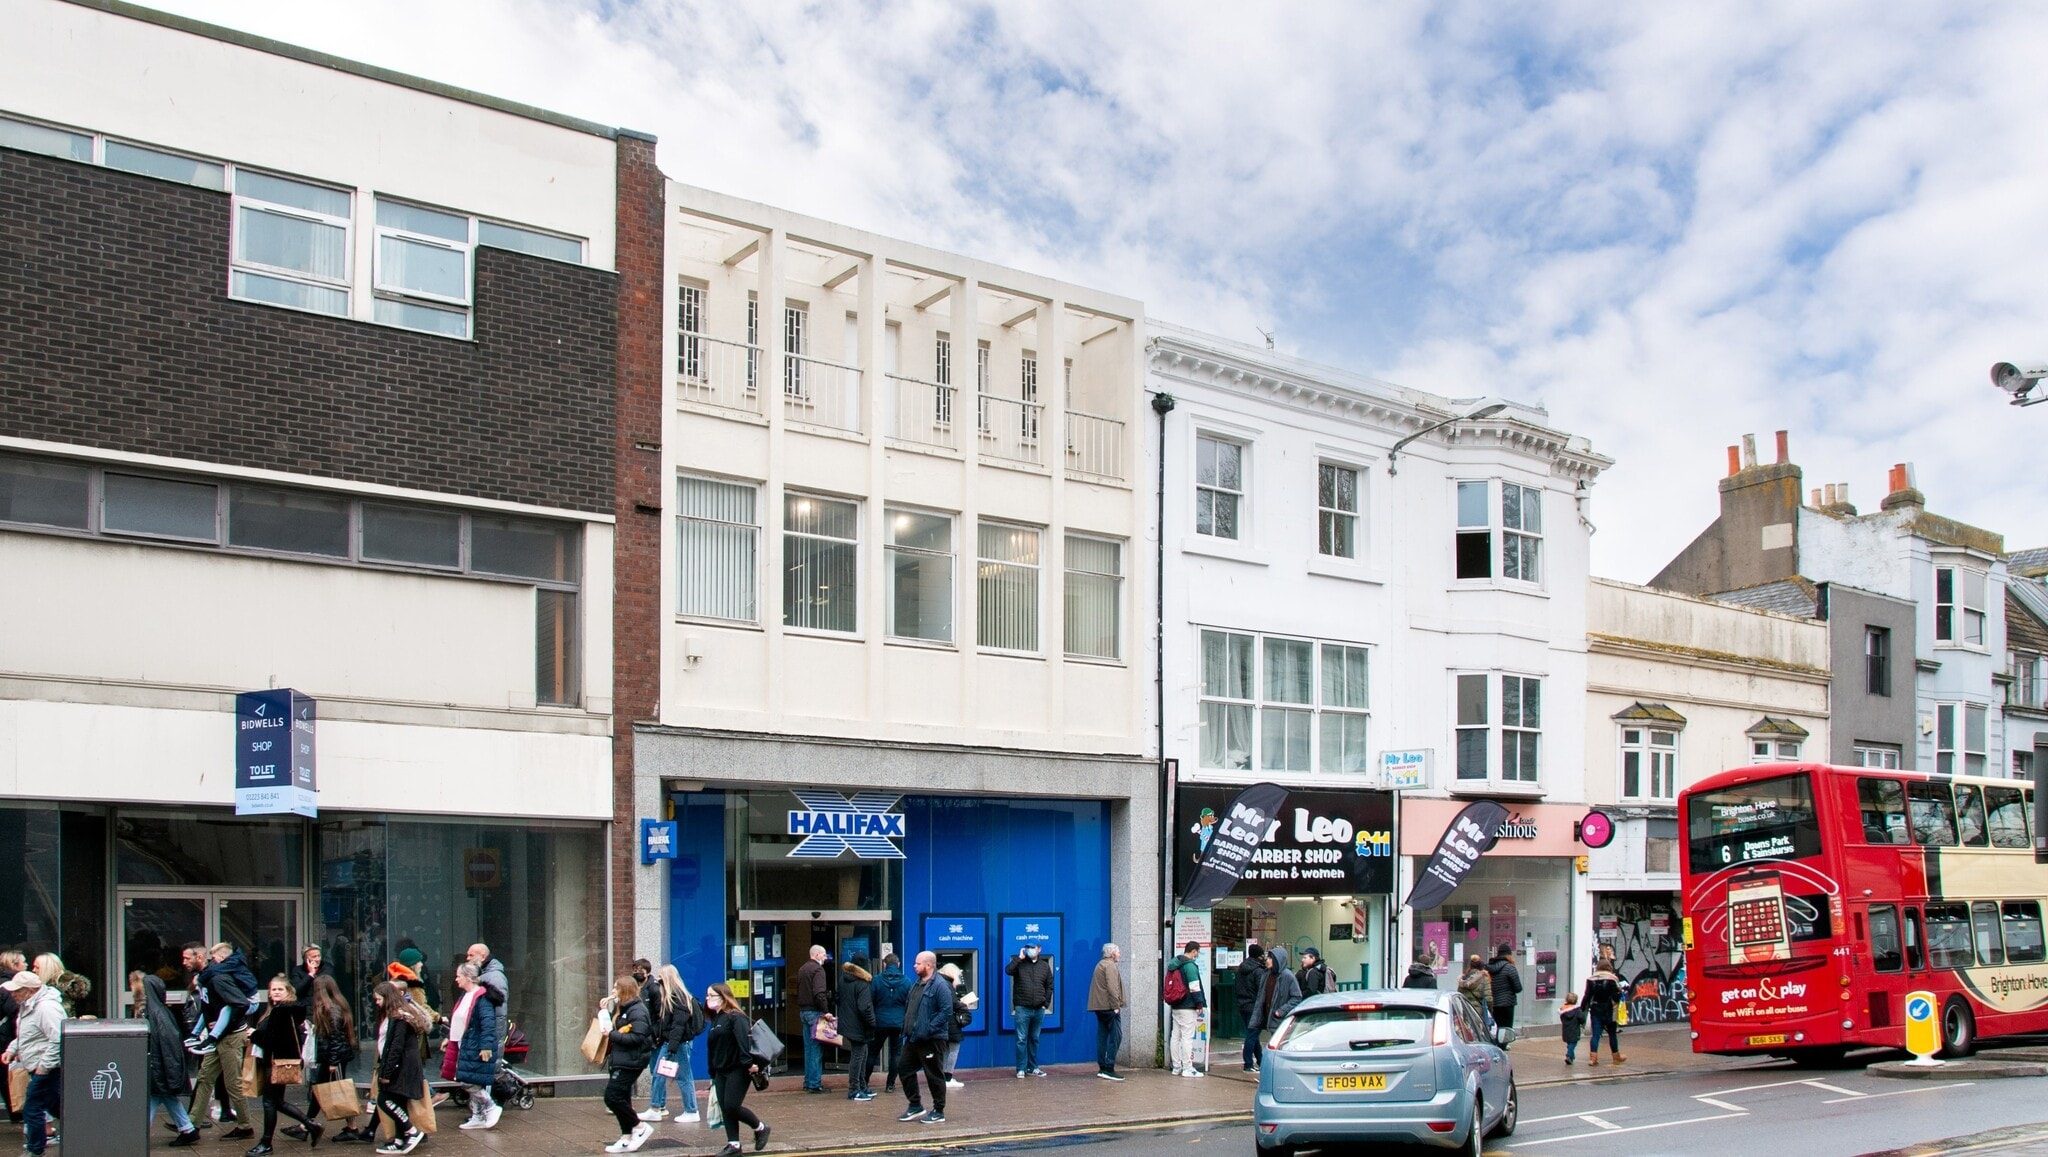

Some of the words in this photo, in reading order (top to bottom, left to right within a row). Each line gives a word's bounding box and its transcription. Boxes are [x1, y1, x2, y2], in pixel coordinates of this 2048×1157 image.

[241, 717, 284, 730] BIDWELLS
[252, 741, 273, 752] SHOP
[1385, 754, 1400, 765] Mr
[1403, 752, 1423, 764] Leo
[250, 765, 261, 775] TO
[261, 764, 275, 775] LET
[1231, 802, 1265, 827] Mr
[1720, 803, 1752, 817] Brighton
[1754, 800, 1776, 810] Hove
[790, 811, 903, 836] HALIFAX
[1218, 818, 1259, 846] Leo
[1294, 807, 1353, 844] Leo
[1456, 815, 1485, 843] Mr
[648, 835, 670, 845] HALIFAX
[1213, 838, 1251, 858] BARBER
[1355, 830, 1391, 857] £11
[1444, 829, 1479, 860] Leo
[1744, 841, 1770, 851] Downs
[1771, 835, 1790, 846] Park
[1217, 847, 1243, 862] SHOP
[1250, 848, 1302, 864] ARBER
[1304, 848, 1343, 864] SHOP
[1438, 847, 1471, 870] BARBER
[1721, 845, 1731, 863] 6
[1742, 850, 1750, 859] &
[1751, 845, 1795, 858] Sainsburys
[1241, 868, 1259, 879] or
[1260, 868, 1289, 879] men
[1290, 866, 1299, 879] &
[1301, 867, 1345, 879] women
[1440, 857, 1463, 874] SHOP
[1833, 948, 1850, 957] 441
[1721, 988, 1739, 1004] get
[1741, 988, 1757, 998] on
[1758, 977, 1781, 1001] &
[1780, 981, 1807, 998] play
[1991, 974, 2025, 997] Brighton
[2028, 973, 2048, 989] Hove
[1723, 1010, 1736, 1018] free
[1736, 1007, 1754, 1017] WiFi
[1765, 1006, 1774, 1014] all
[1787, 1005, 1808, 1013] buses
[1326, 1076, 1357, 1088] EF09
[1360, 1075, 1383, 1087] VAX
